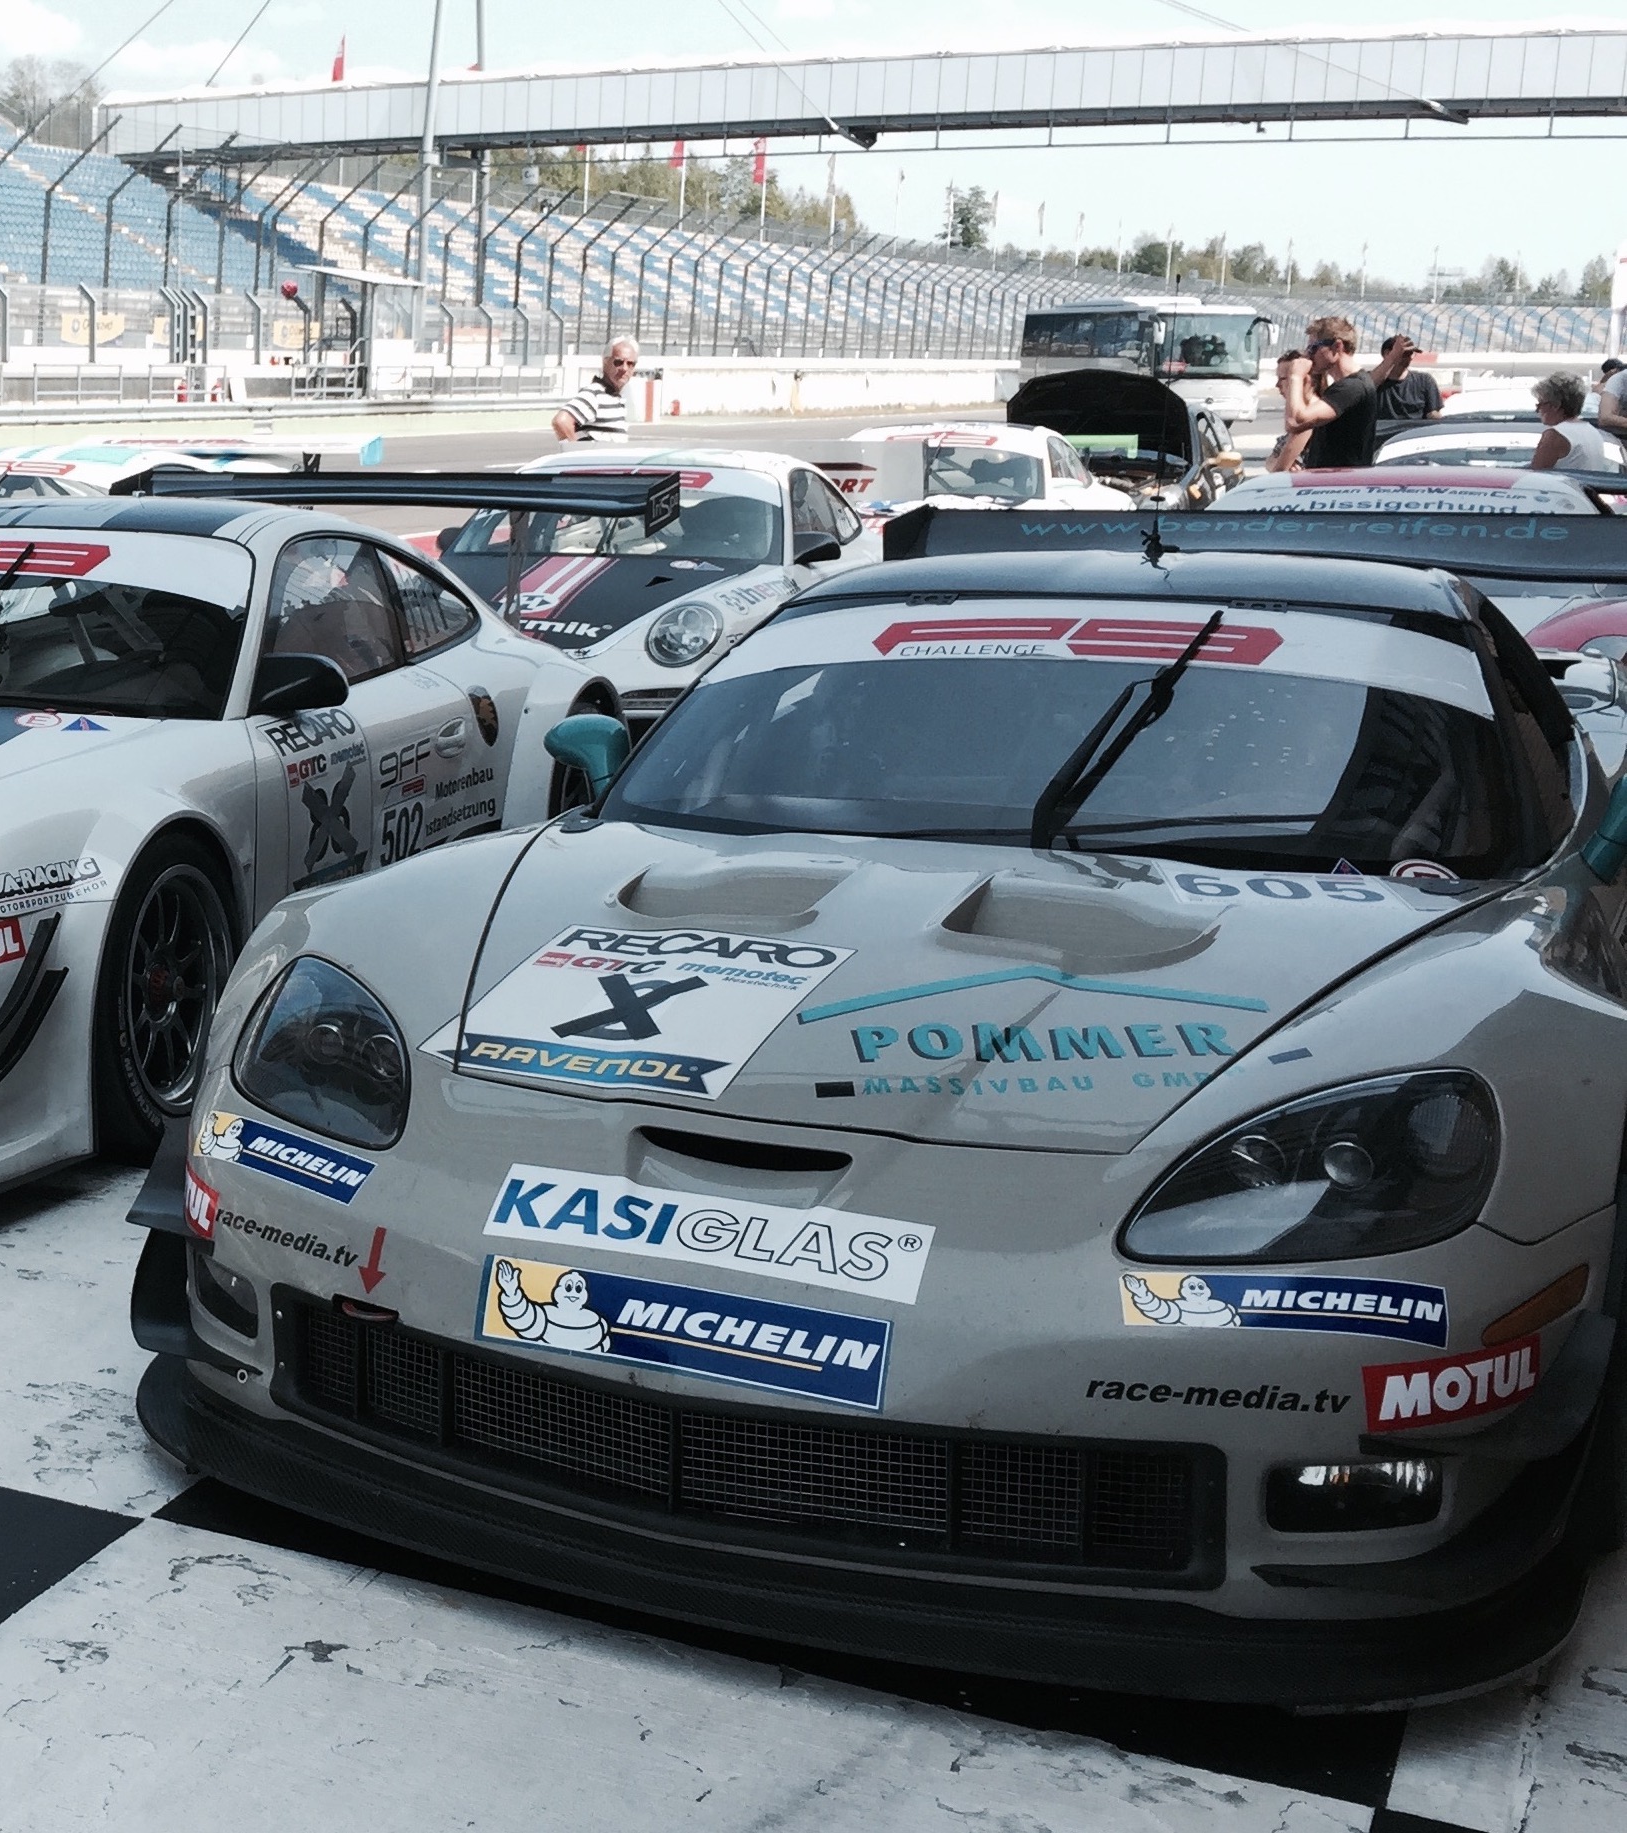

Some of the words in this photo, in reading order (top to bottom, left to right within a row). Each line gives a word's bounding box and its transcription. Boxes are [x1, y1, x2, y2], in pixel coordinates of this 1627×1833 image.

[1021, 515, 1571, 542] wwwbender-reifen.de
[900, 643, 1046, 657] CHALLENGE
[264, 708, 356, 757] RECARO
[299, 753, 327, 780] GTC
[435, 767, 494, 801] Motorenbau
[380, 801, 424, 867] 502
[426, 798, 496, 837] standsetzung
[1174, 873, 1385, 902] 605
[557, 928, 838, 968] RECARO
[571, 956, 667, 975] GTC
[676, 962, 808, 985] memotec
[851, 1021, 1239, 1064] POMMER
[862, 1075, 1094, 1096] MASSIVBAU
[248, 1136, 368, 1188] MICHELIN
[215, 1208, 359, 1268] race-media.tv
[1241, 1289, 1444, 1323] MICHELIN
[617, 1299, 881, 1371] MICHELIN
[1086, 1379, 1352, 1415] race-media.tv
[1378, 1346, 1536, 1421] MOTUL
